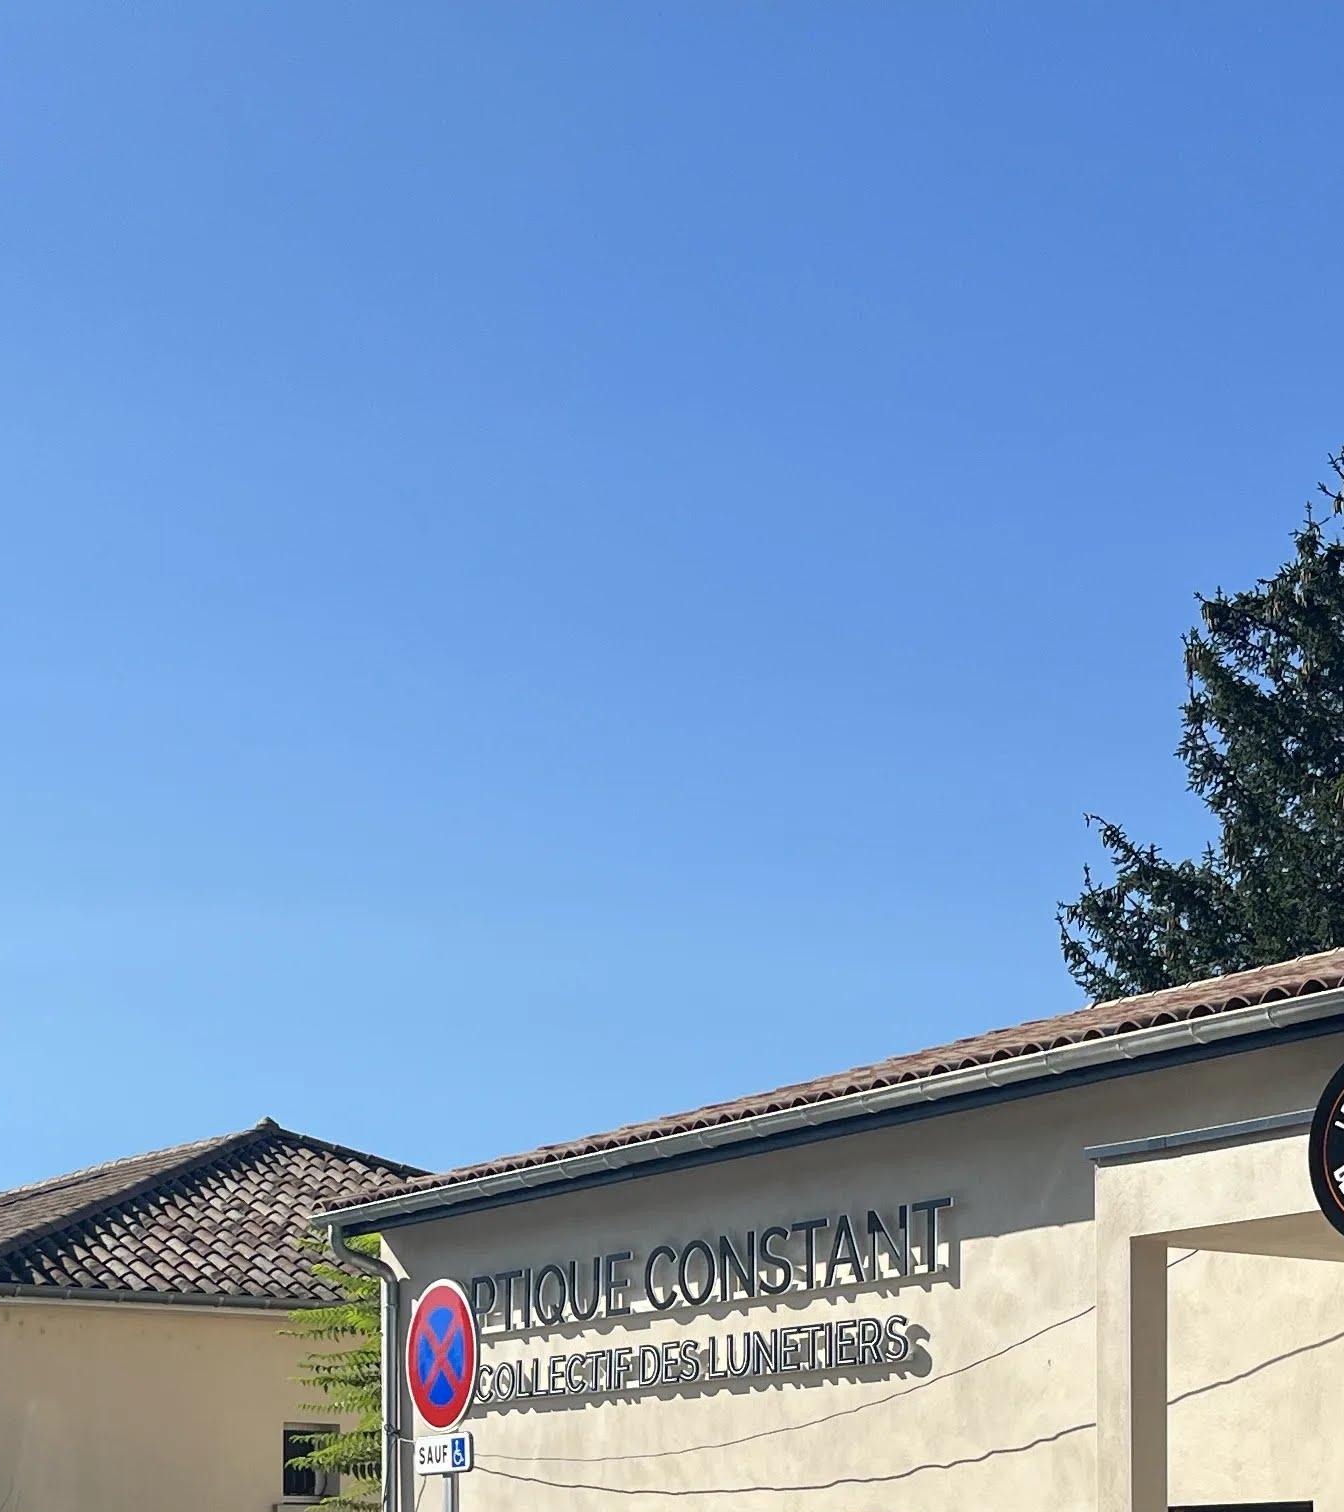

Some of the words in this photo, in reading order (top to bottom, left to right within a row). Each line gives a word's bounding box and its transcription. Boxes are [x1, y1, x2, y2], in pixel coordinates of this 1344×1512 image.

[462, 1251, 633, 1331] PTIQUE
[645, 1196, 954, 1311] CONSTANT
[476, 1347, 632, 1403] COLLECTIF
[638, 1340, 701, 1387] DES
[709, 1314, 909, 1380] LUNETIERS
[419, 1445, 448, 1465] SAUF
